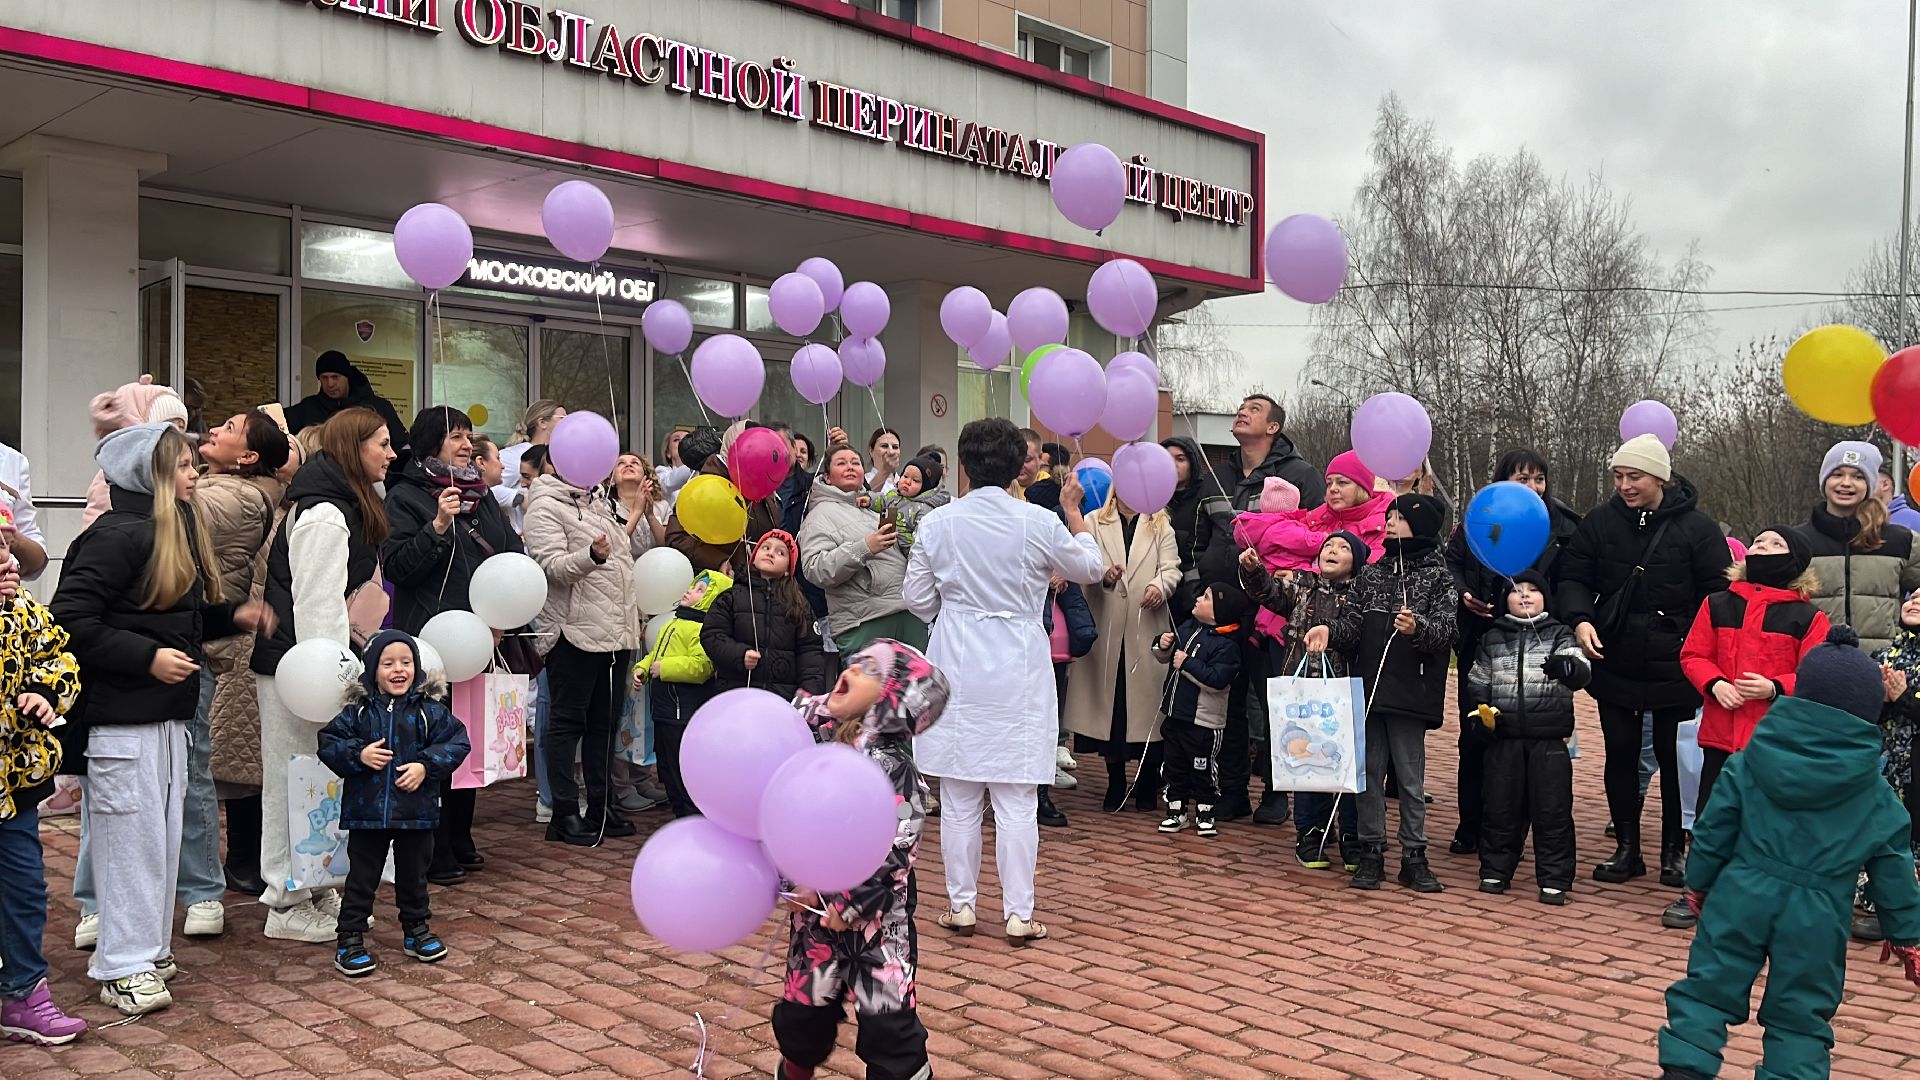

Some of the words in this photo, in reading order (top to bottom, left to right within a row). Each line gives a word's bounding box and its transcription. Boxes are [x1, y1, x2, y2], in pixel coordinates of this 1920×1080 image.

[456, 0, 805, 121] ОБЛАСТНОЙ
[812, 80, 1155, 204] ПЕРИНАТАЛЙ
[1160, 171, 1254, 226] ЦЕНТР
[496, 706, 523, 734] BABY
[308, 798, 342, 831] BA
